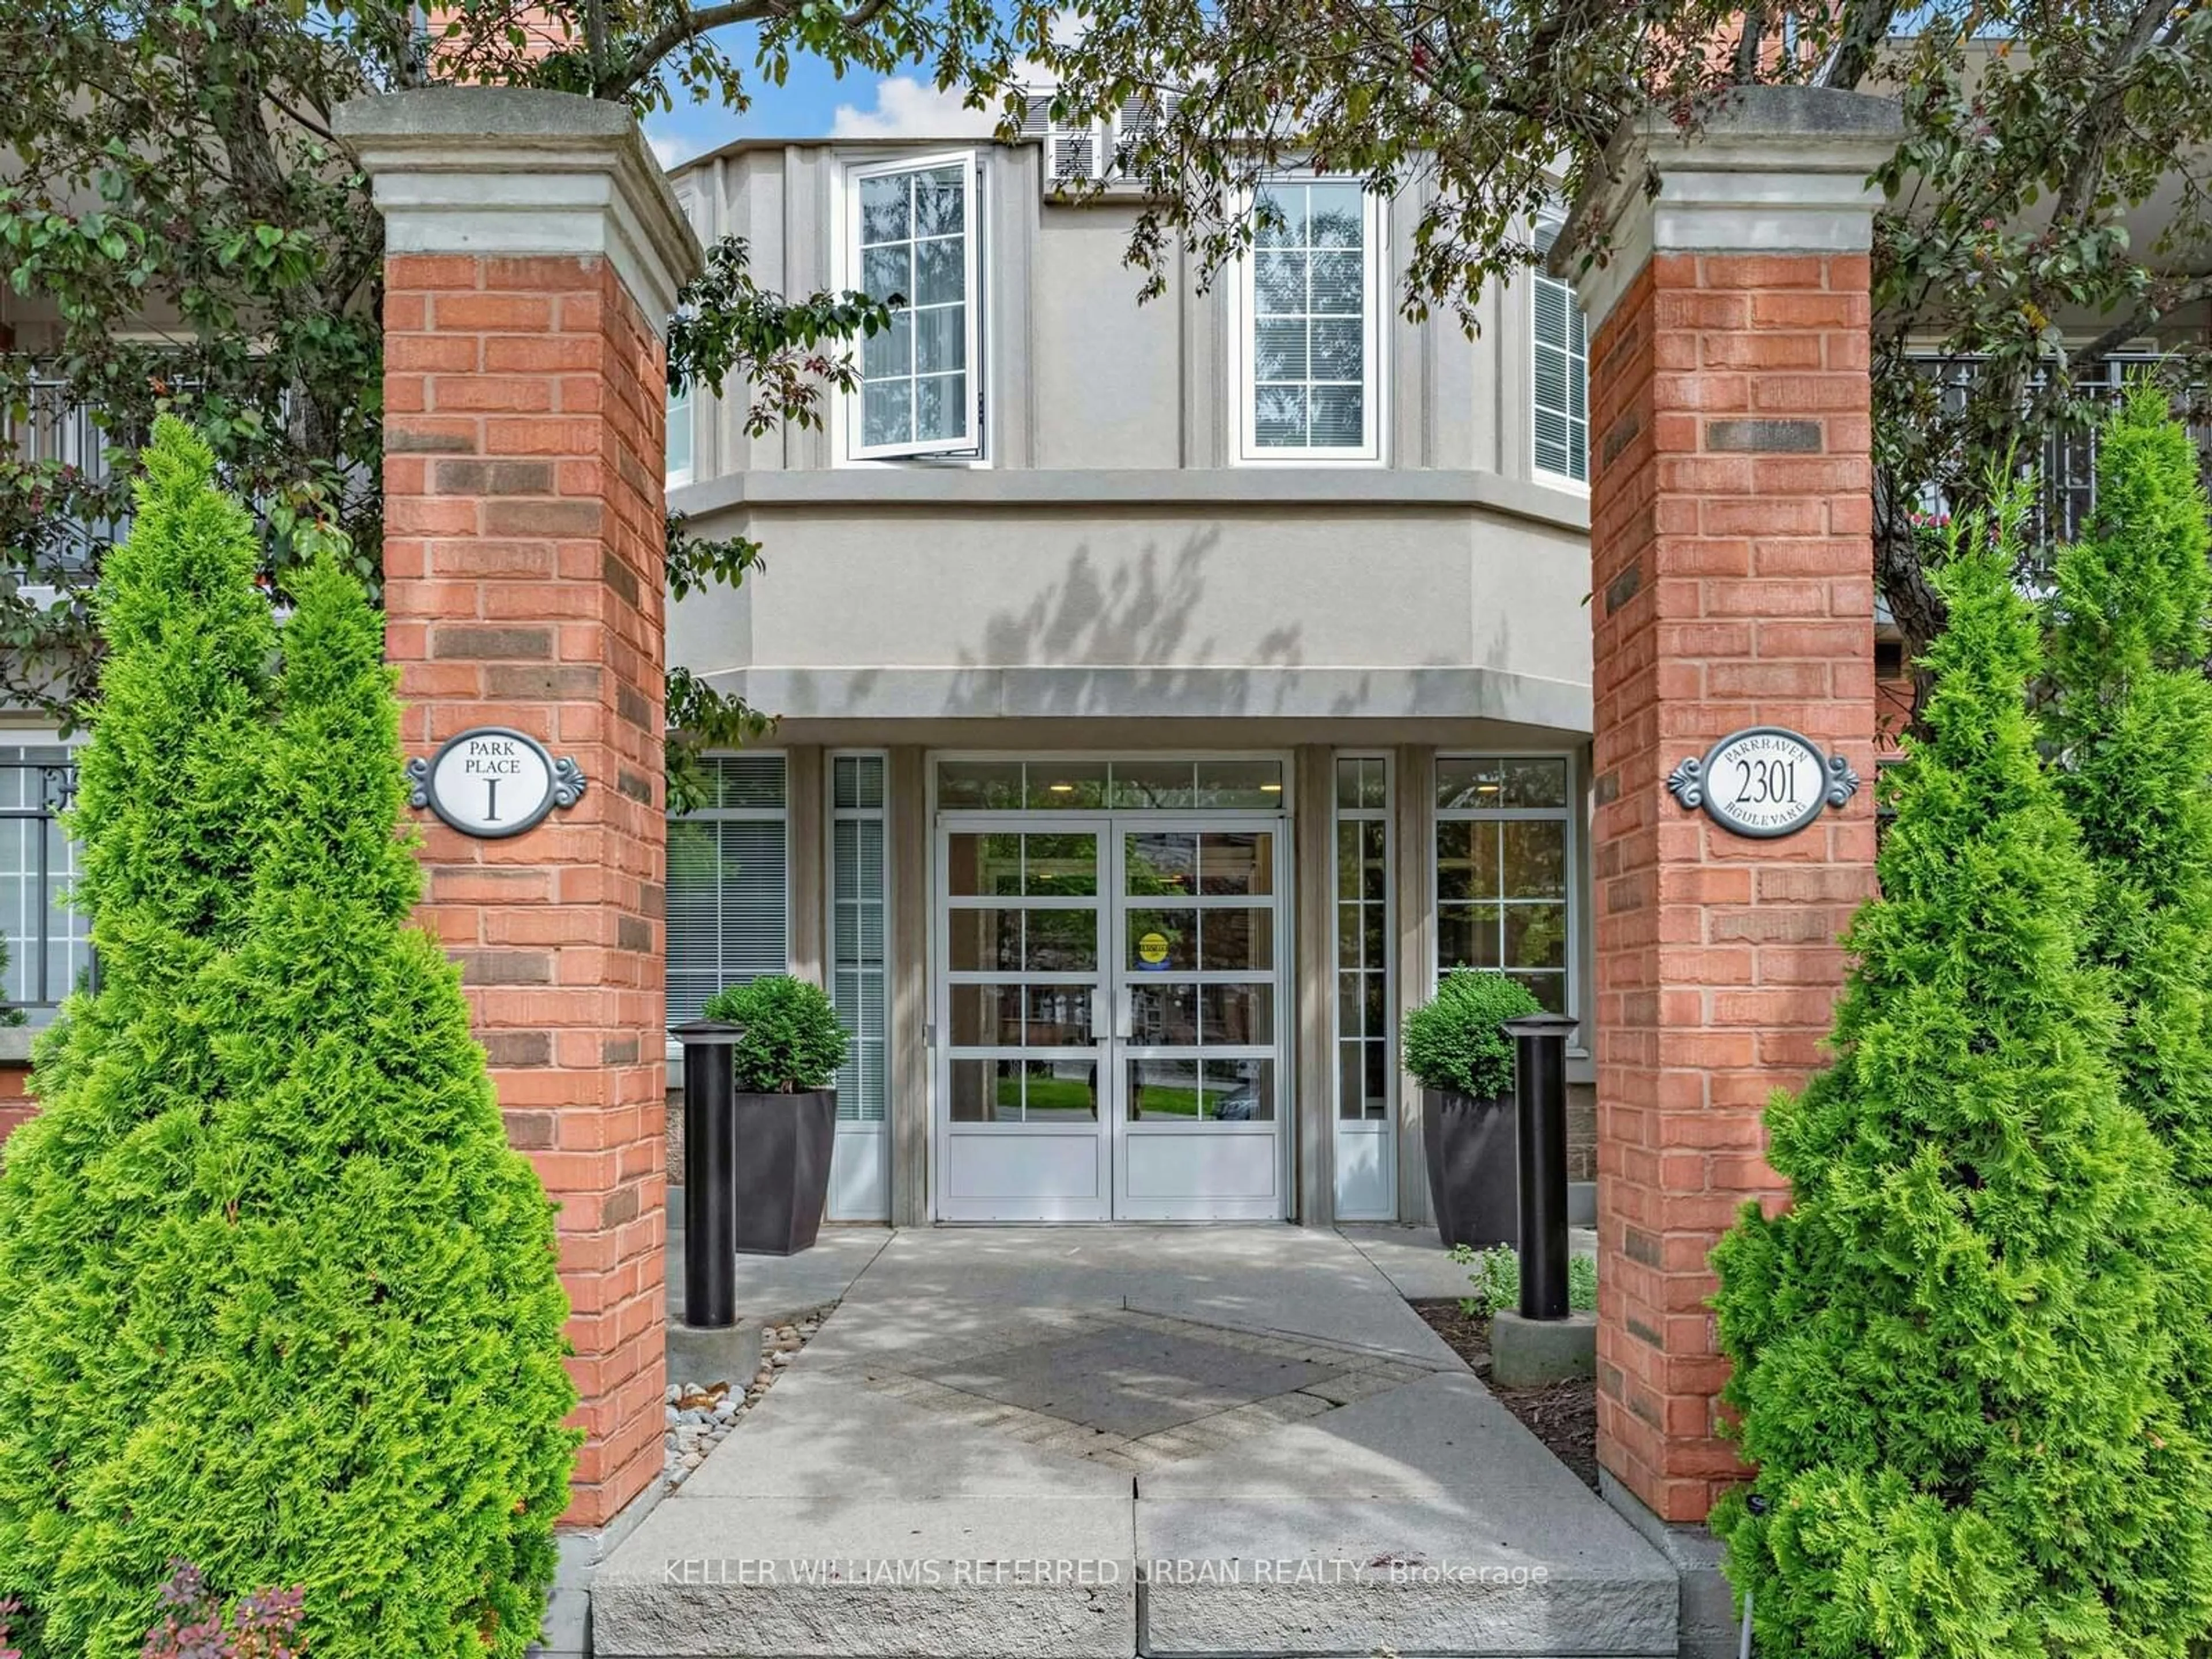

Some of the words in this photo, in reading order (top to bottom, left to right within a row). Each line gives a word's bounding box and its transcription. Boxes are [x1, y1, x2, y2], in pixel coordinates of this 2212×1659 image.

[469, 741, 514, 755] PARK
[1724, 738, 1808, 763] PARKHAVEN
[465, 760, 521, 774] PLACE
[1736, 759, 1798, 803] 2301
[1724, 801, 1807, 826] BOULEVARD
